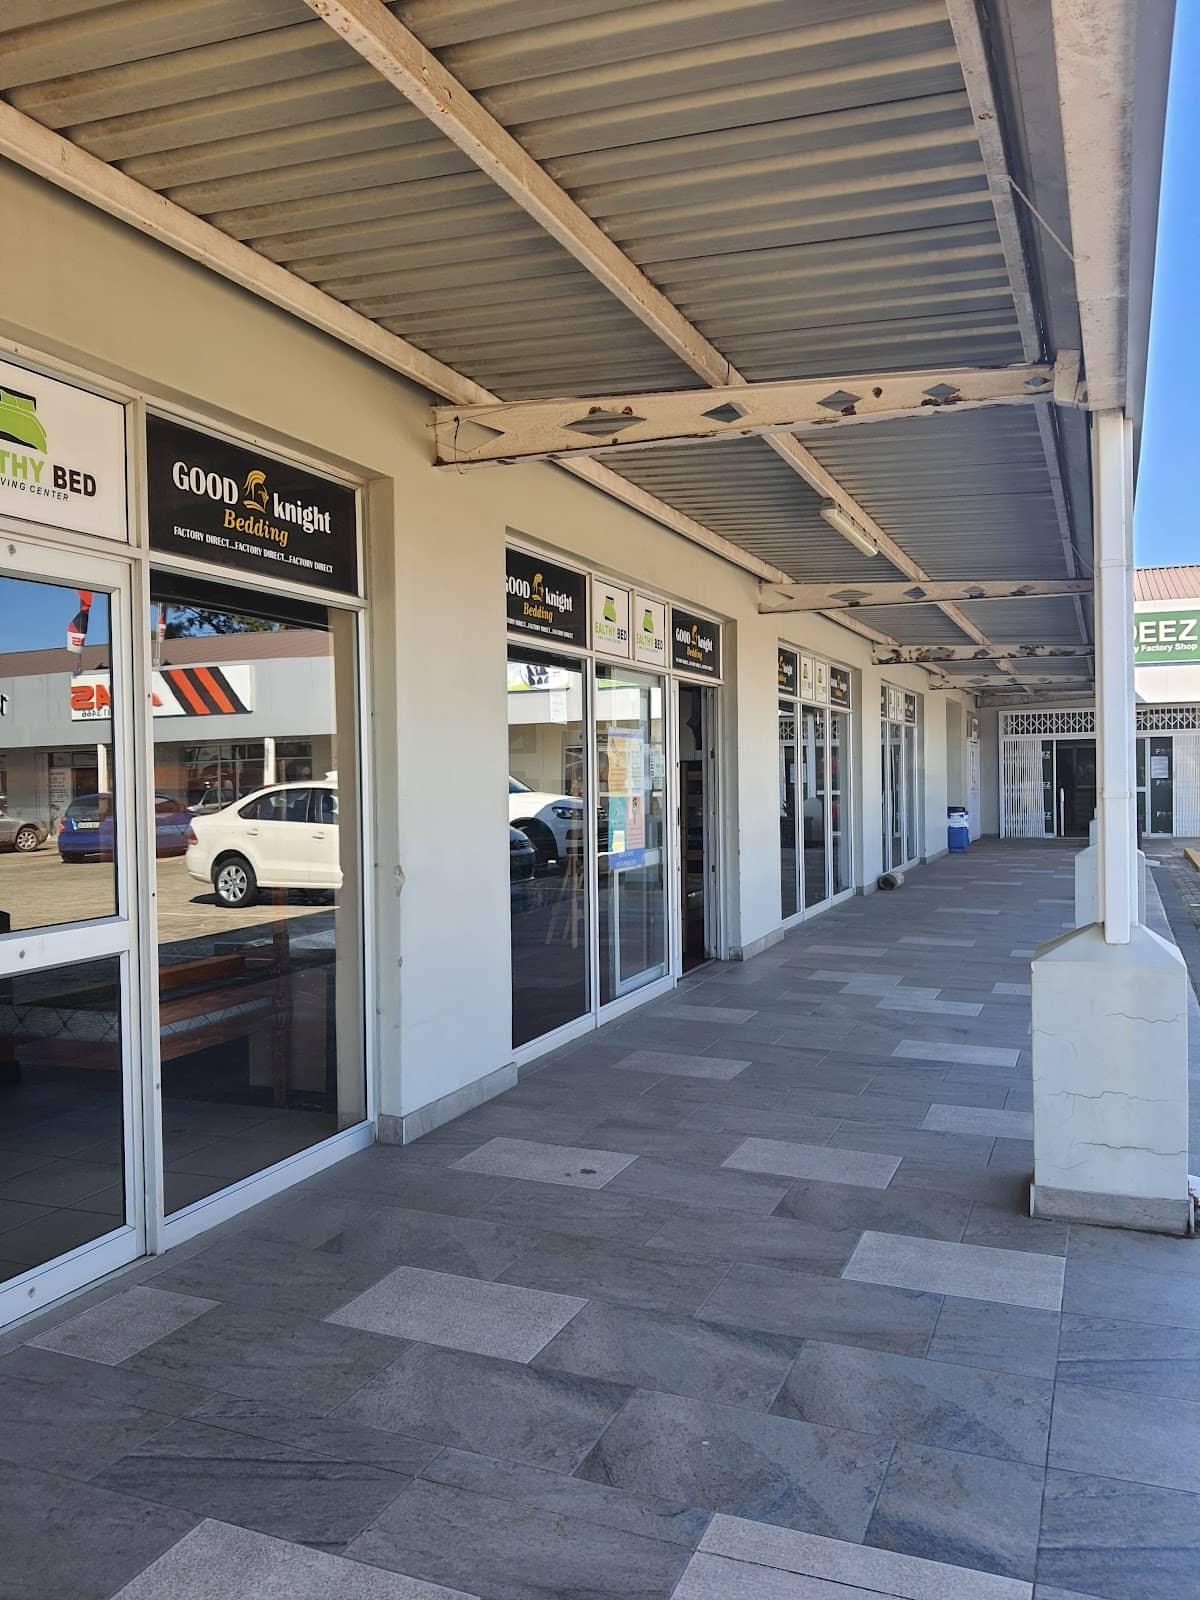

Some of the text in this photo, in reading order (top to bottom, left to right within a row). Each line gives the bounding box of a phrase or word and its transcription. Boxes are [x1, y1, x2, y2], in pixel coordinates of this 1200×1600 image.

[53, 464, 97, 497] BED
[29, 485, 69, 502] CENTER
[173, 461, 332, 534] GOOD knight
[173, 525, 204, 542] FACTORY
[223, 508, 289, 548] Bedding
[523, 601, 553, 624] Bedding
[545, 587, 573, 613] knight
[1133, 618, 1198, 643] EEZ
[1141, 644, 1174, 653] Factory
[1174, 642, 1198, 652] Shop
